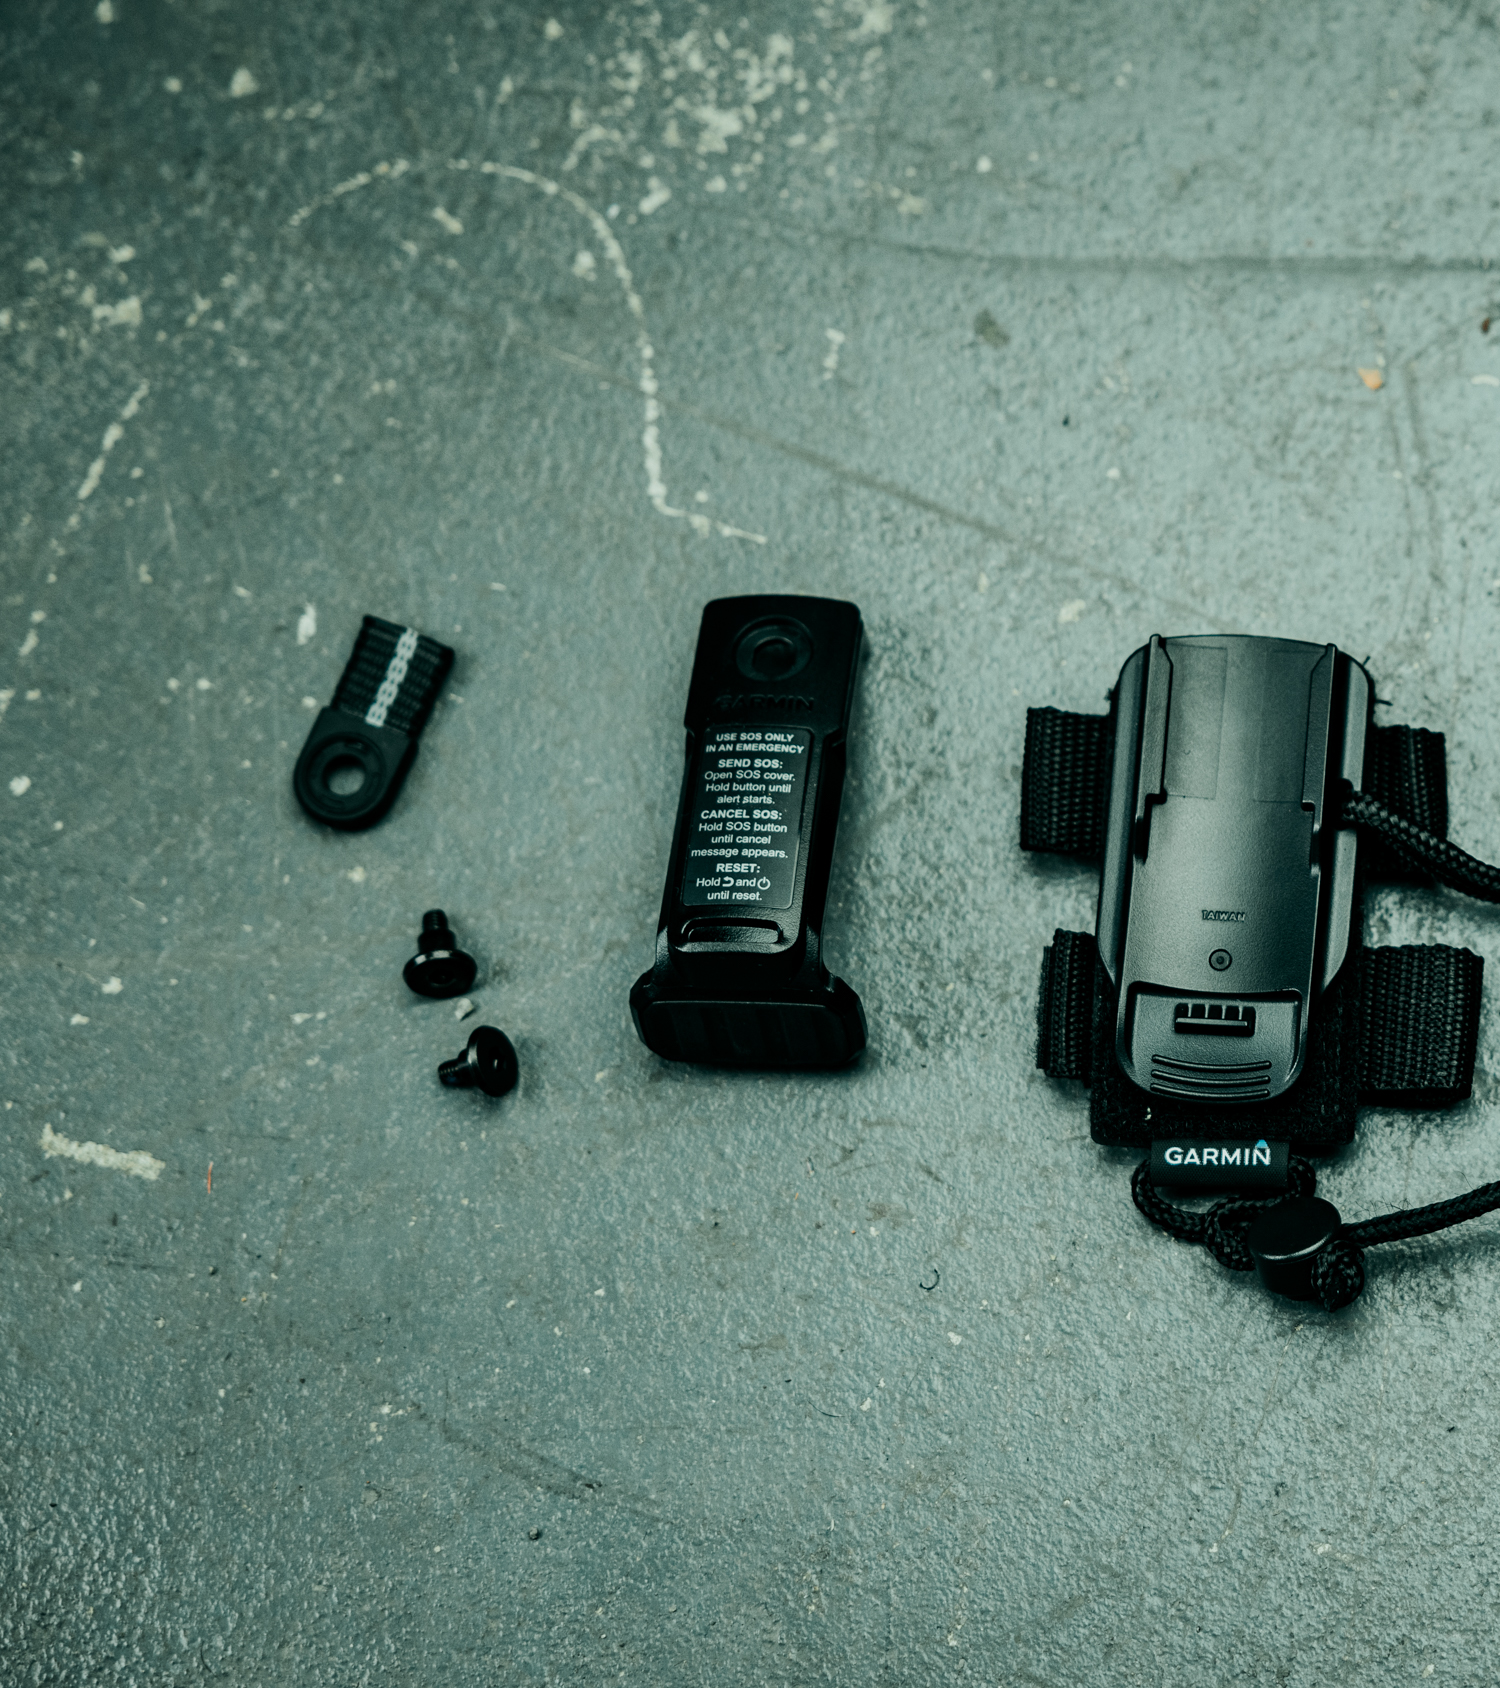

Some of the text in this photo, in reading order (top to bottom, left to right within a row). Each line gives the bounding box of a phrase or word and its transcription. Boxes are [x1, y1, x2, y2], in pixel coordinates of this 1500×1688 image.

[716, 732, 794, 742] USE SOS ONLY
[705, 743, 804, 754] IN AN EMERGENCY
[718, 759, 783, 769] SEND SOS:
[704, 770, 796, 781] Open SOS cover.
[705, 783, 792, 793] Hold button until
[716, 795, 776, 805] alert starts.
[700, 809, 783, 820] CANCEL SOS:
[698, 821, 788, 833] Hold SOS button
[711, 834, 772, 844] until cancel
[691, 848, 789, 859] message appears.
[716, 863, 761, 873] RESET:
[696, 878, 757, 887] Hold and
[707, 891, 763, 901] until reset.
[1201, 909, 1246, 922] TAIWAN
[1164, 1146, 1272, 1166] GARMIN
